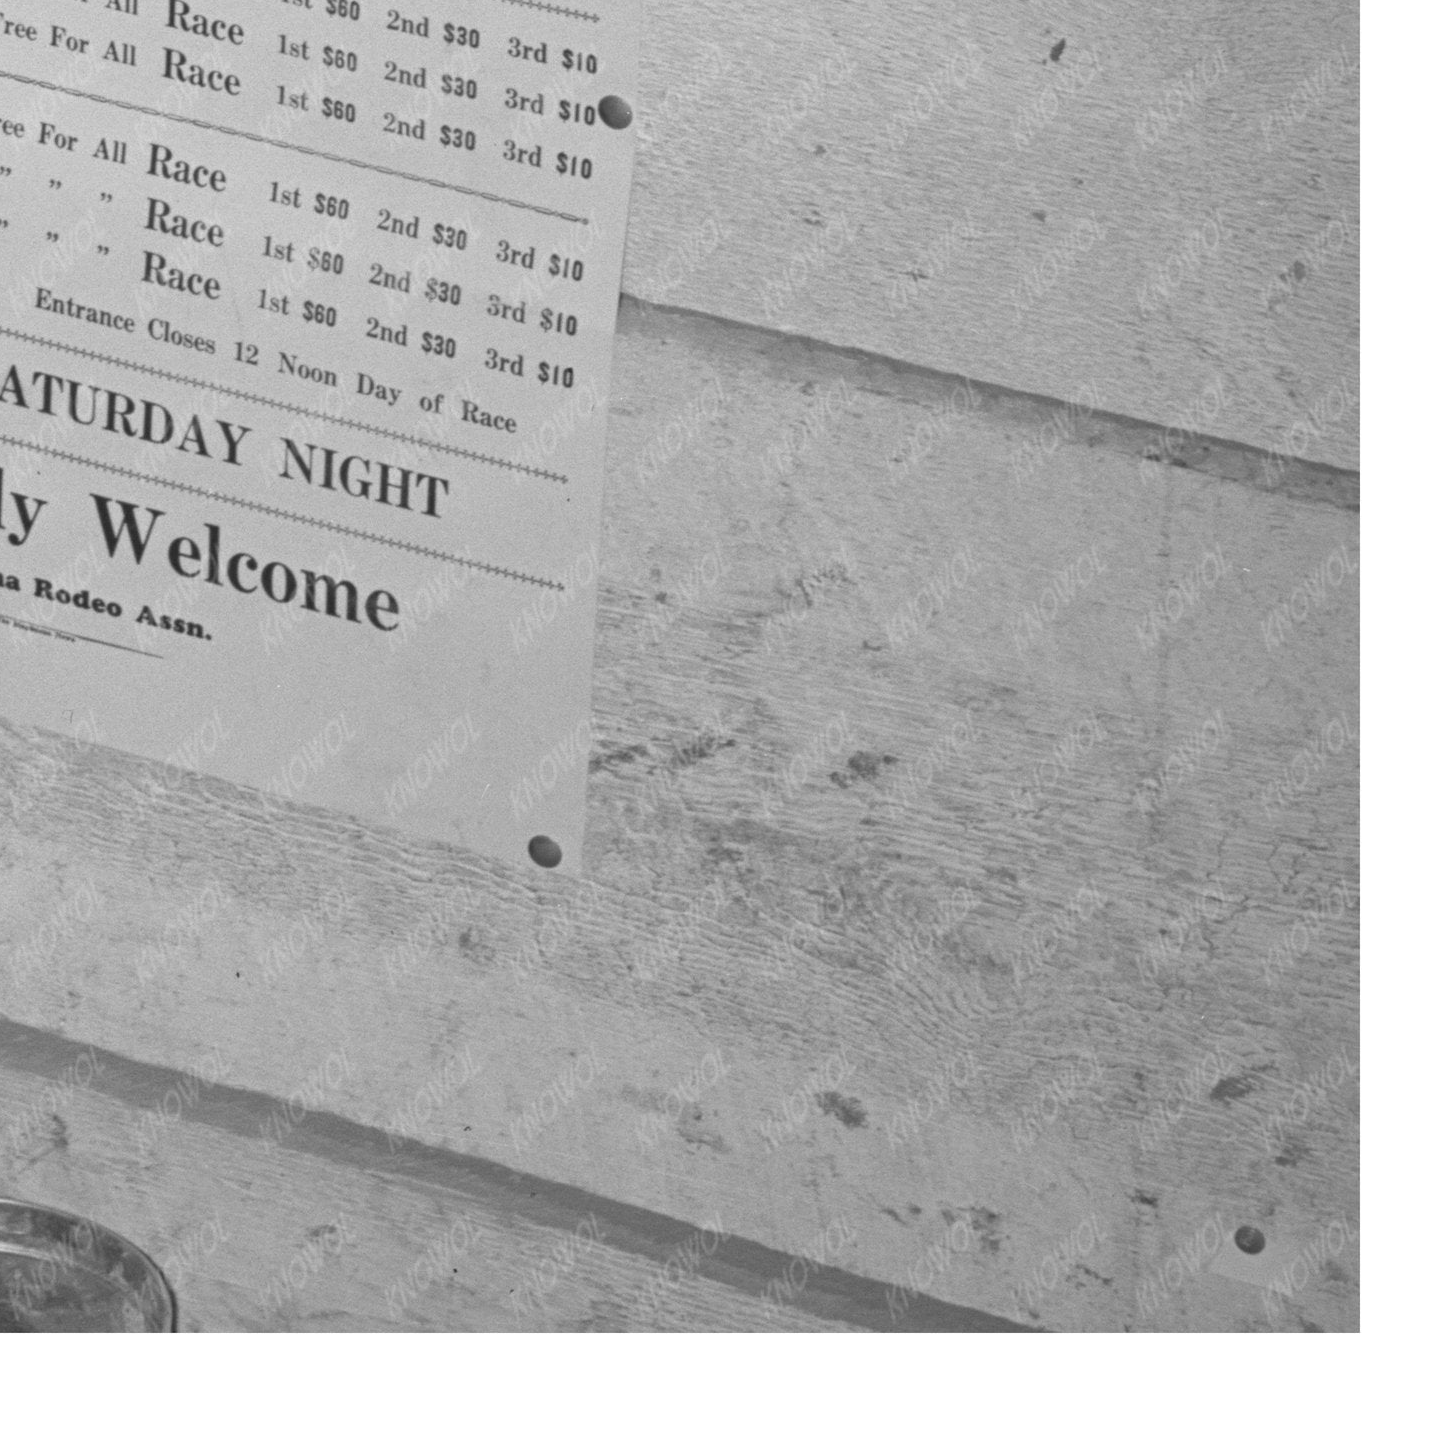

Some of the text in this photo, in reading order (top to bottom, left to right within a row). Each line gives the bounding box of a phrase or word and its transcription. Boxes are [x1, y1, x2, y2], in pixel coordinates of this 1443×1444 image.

[278, 436, 451, 519] NIGHT
[88, 492, 402, 633] Welcome
[32, 576, 123, 620] Rodeo
[134, 603, 214, 642] Assn.
